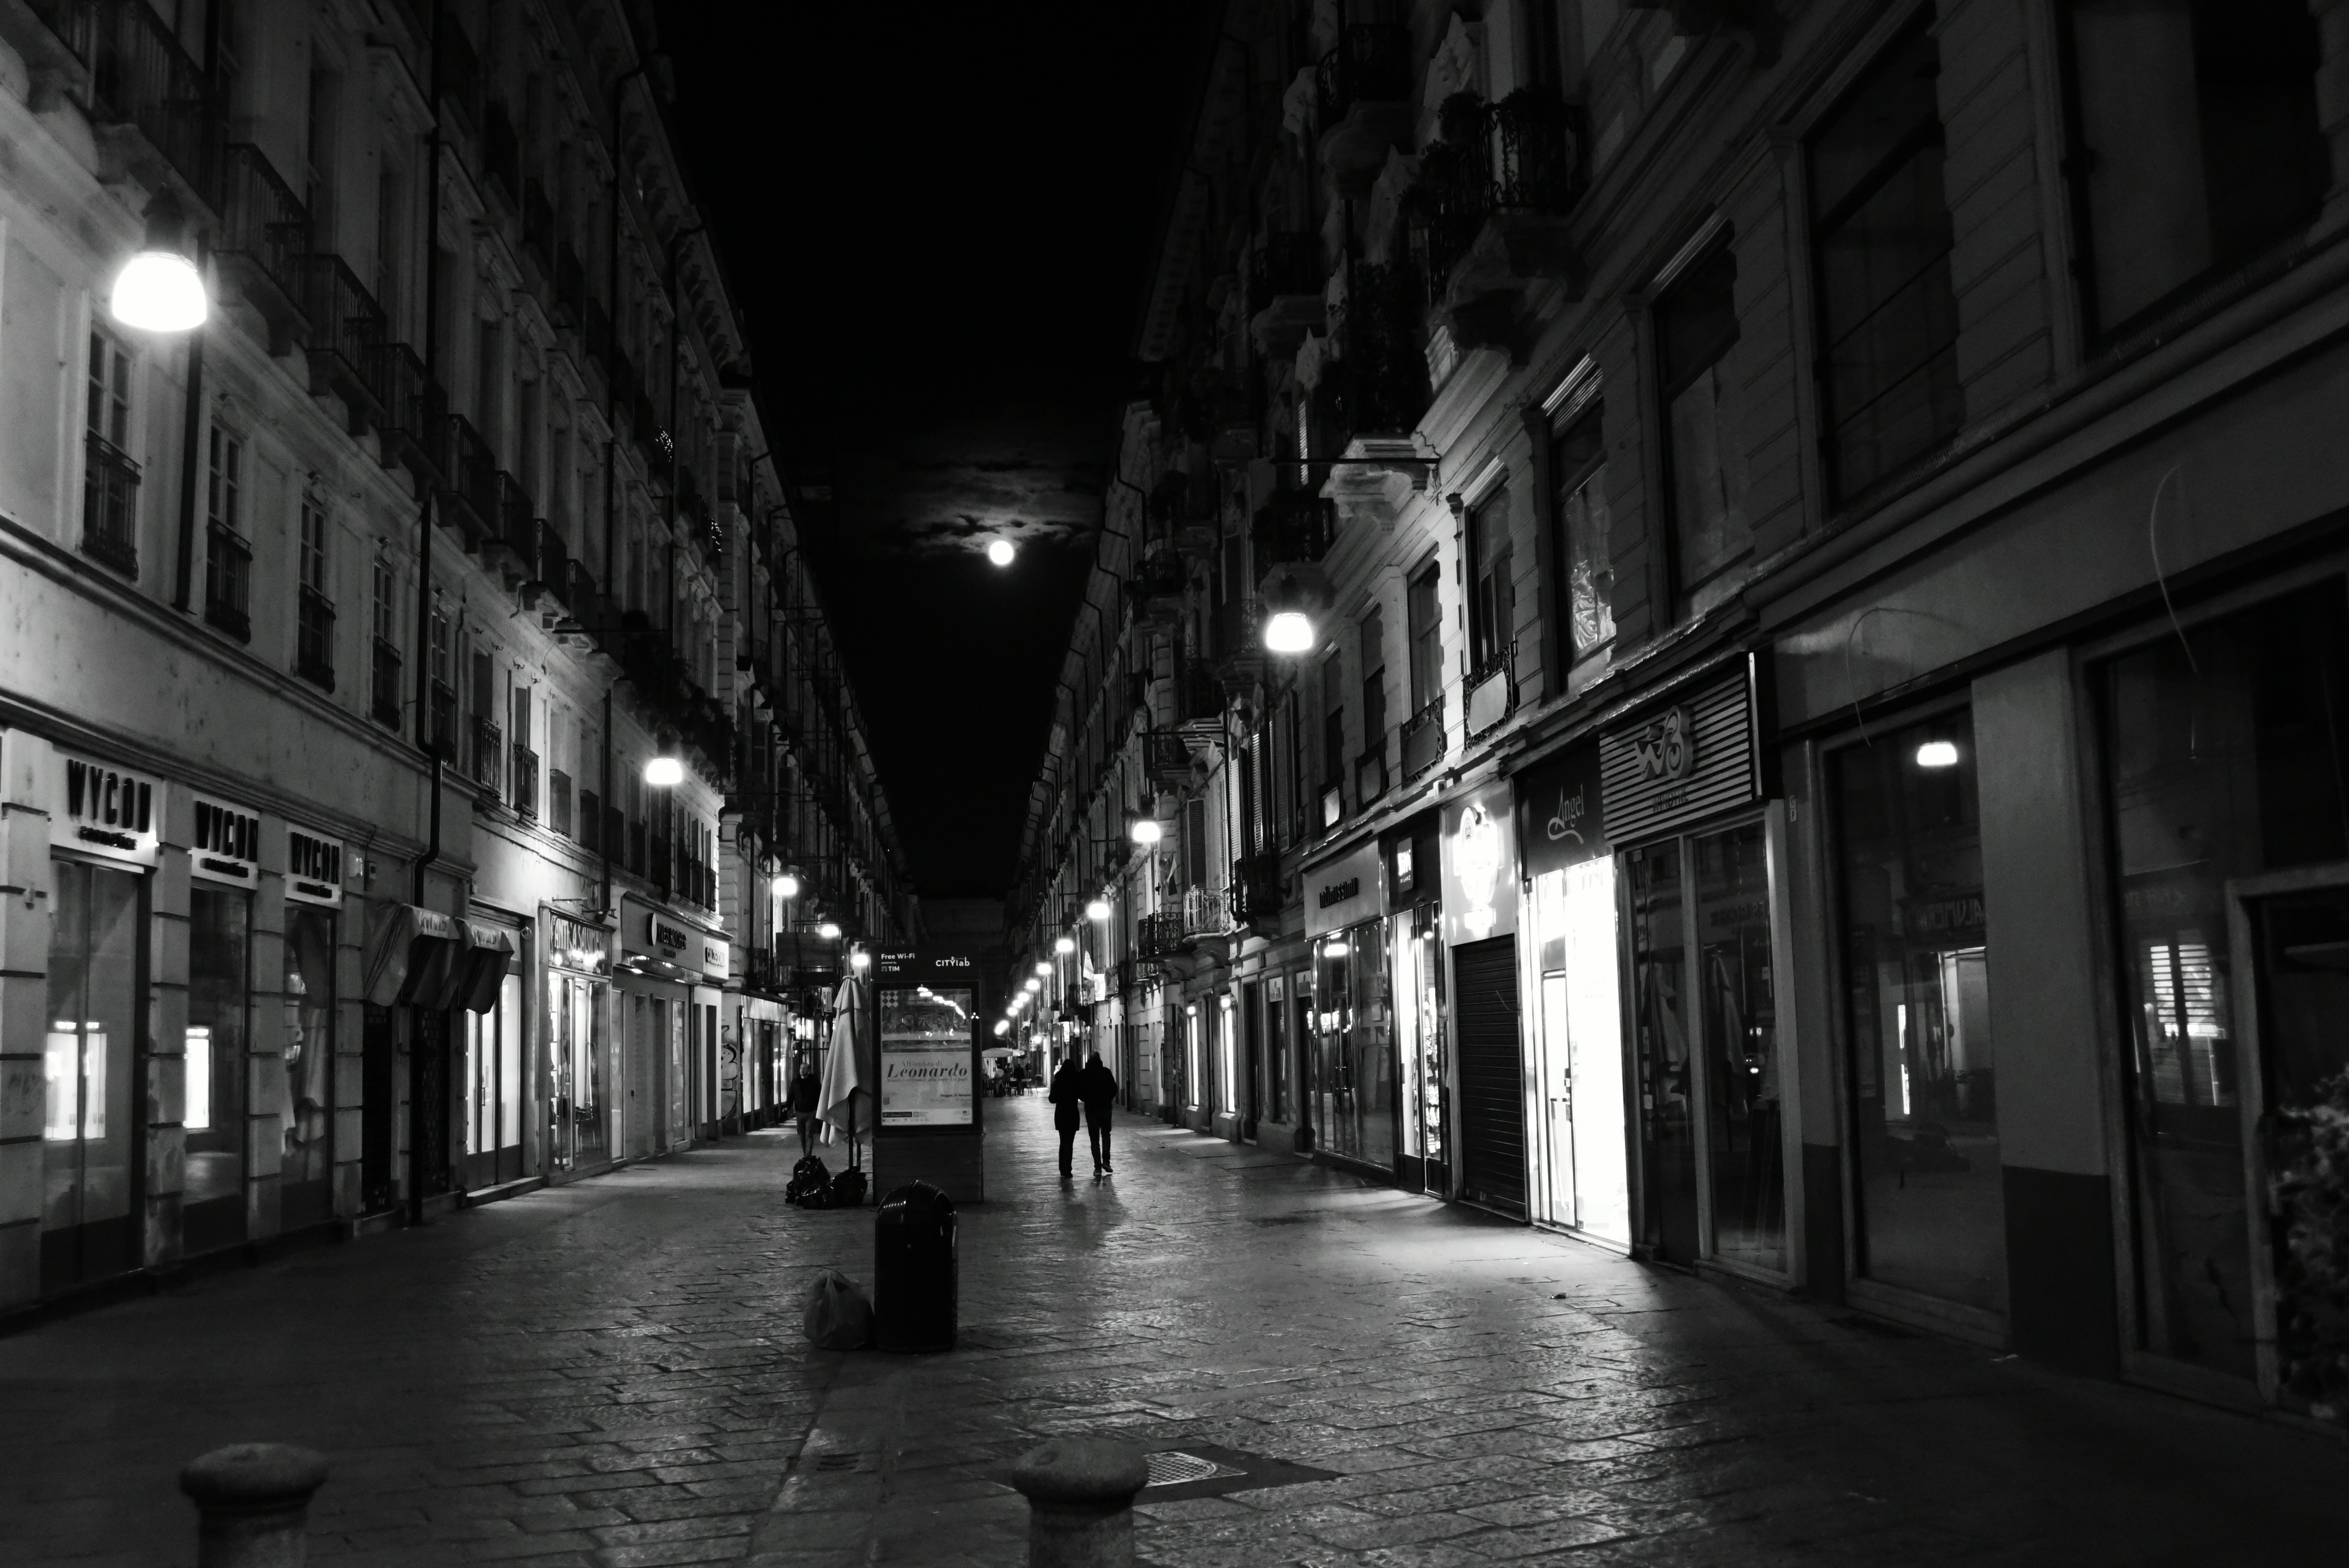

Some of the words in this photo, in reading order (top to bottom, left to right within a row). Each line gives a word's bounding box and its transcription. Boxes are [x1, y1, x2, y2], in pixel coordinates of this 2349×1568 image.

[68, 759, 151, 833] WYCON
[1547, 783, 1584, 845] Angel
[195, 800, 258, 862] WYCON
[291, 832, 340, 884] WYCON
[887, 1063, 968, 1078] Leonardo
